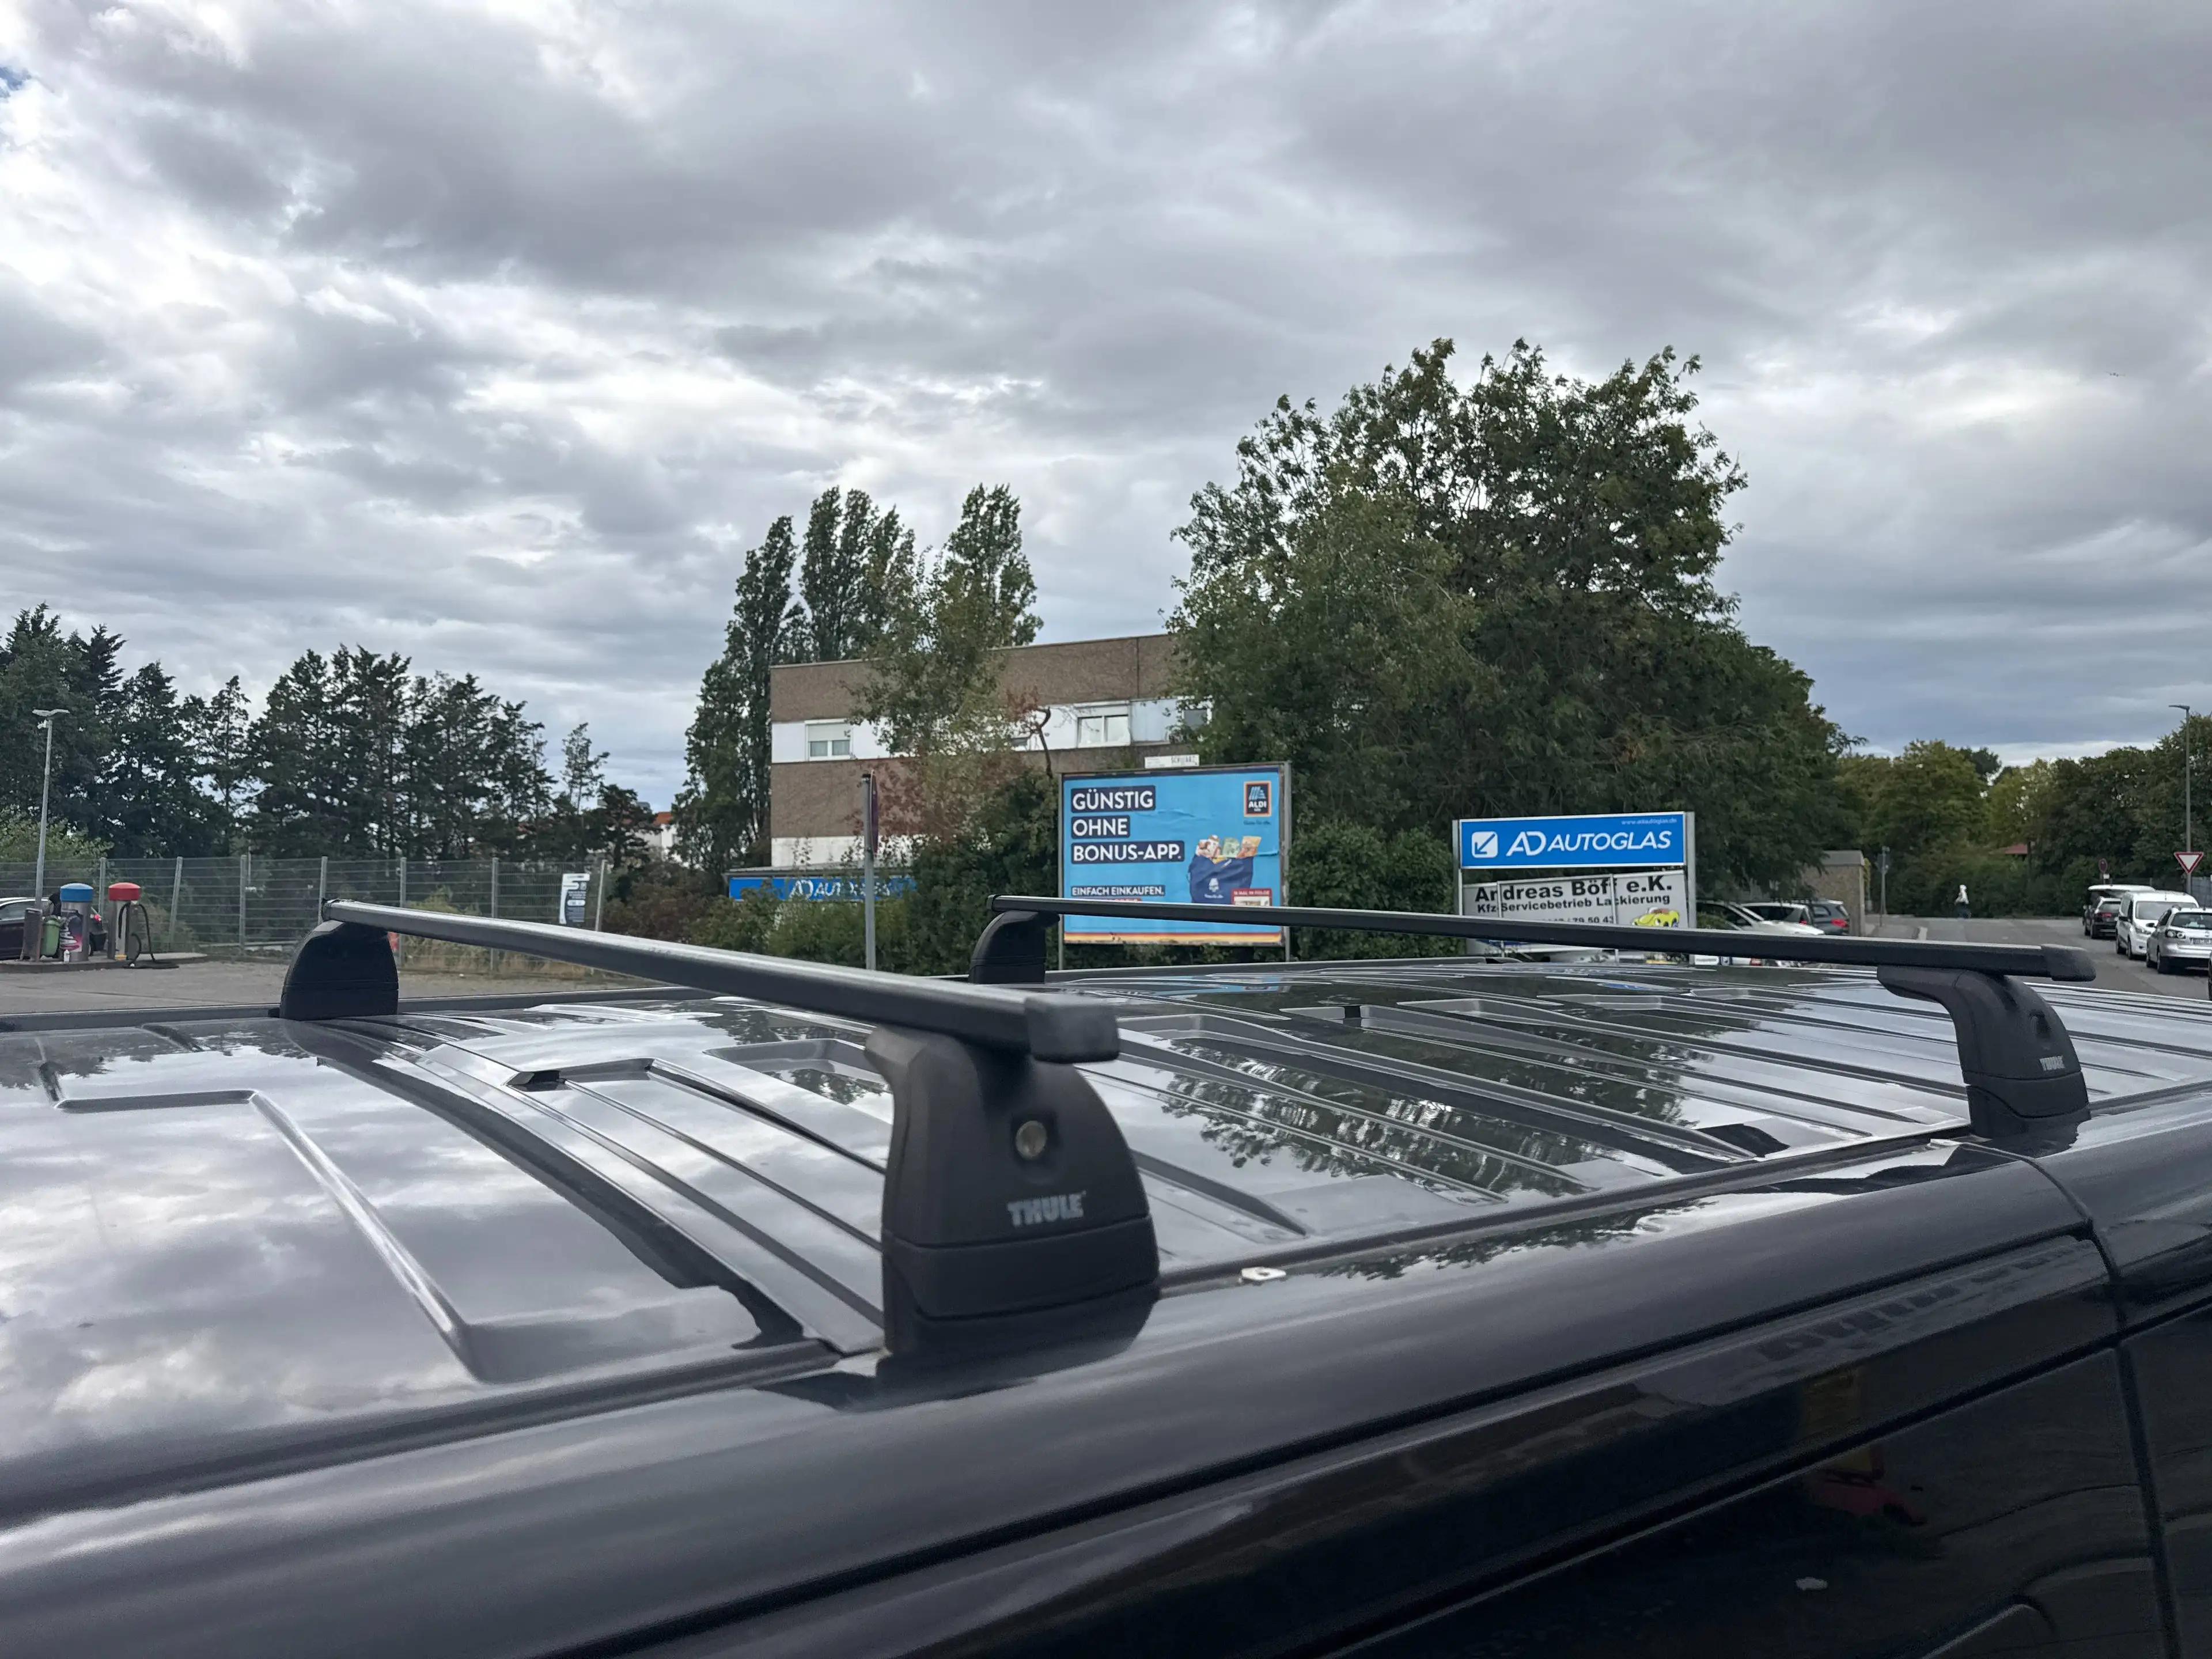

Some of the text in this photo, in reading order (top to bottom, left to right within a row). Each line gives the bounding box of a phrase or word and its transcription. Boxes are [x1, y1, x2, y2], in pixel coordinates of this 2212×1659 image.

[1072, 789, 1154, 810] GÜNSTIG
[1072, 818, 1128, 836] OHNE
[1073, 843, 1182, 862] BONUS-APP.
[1505, 831, 1672, 857] AD AUTOGLAS
[1071, 885, 1164, 896] EINFACH EINKAUFEN.
[1626, 875, 1672, 893] e.K.
[1007, 1192, 1085, 1228] THULE
